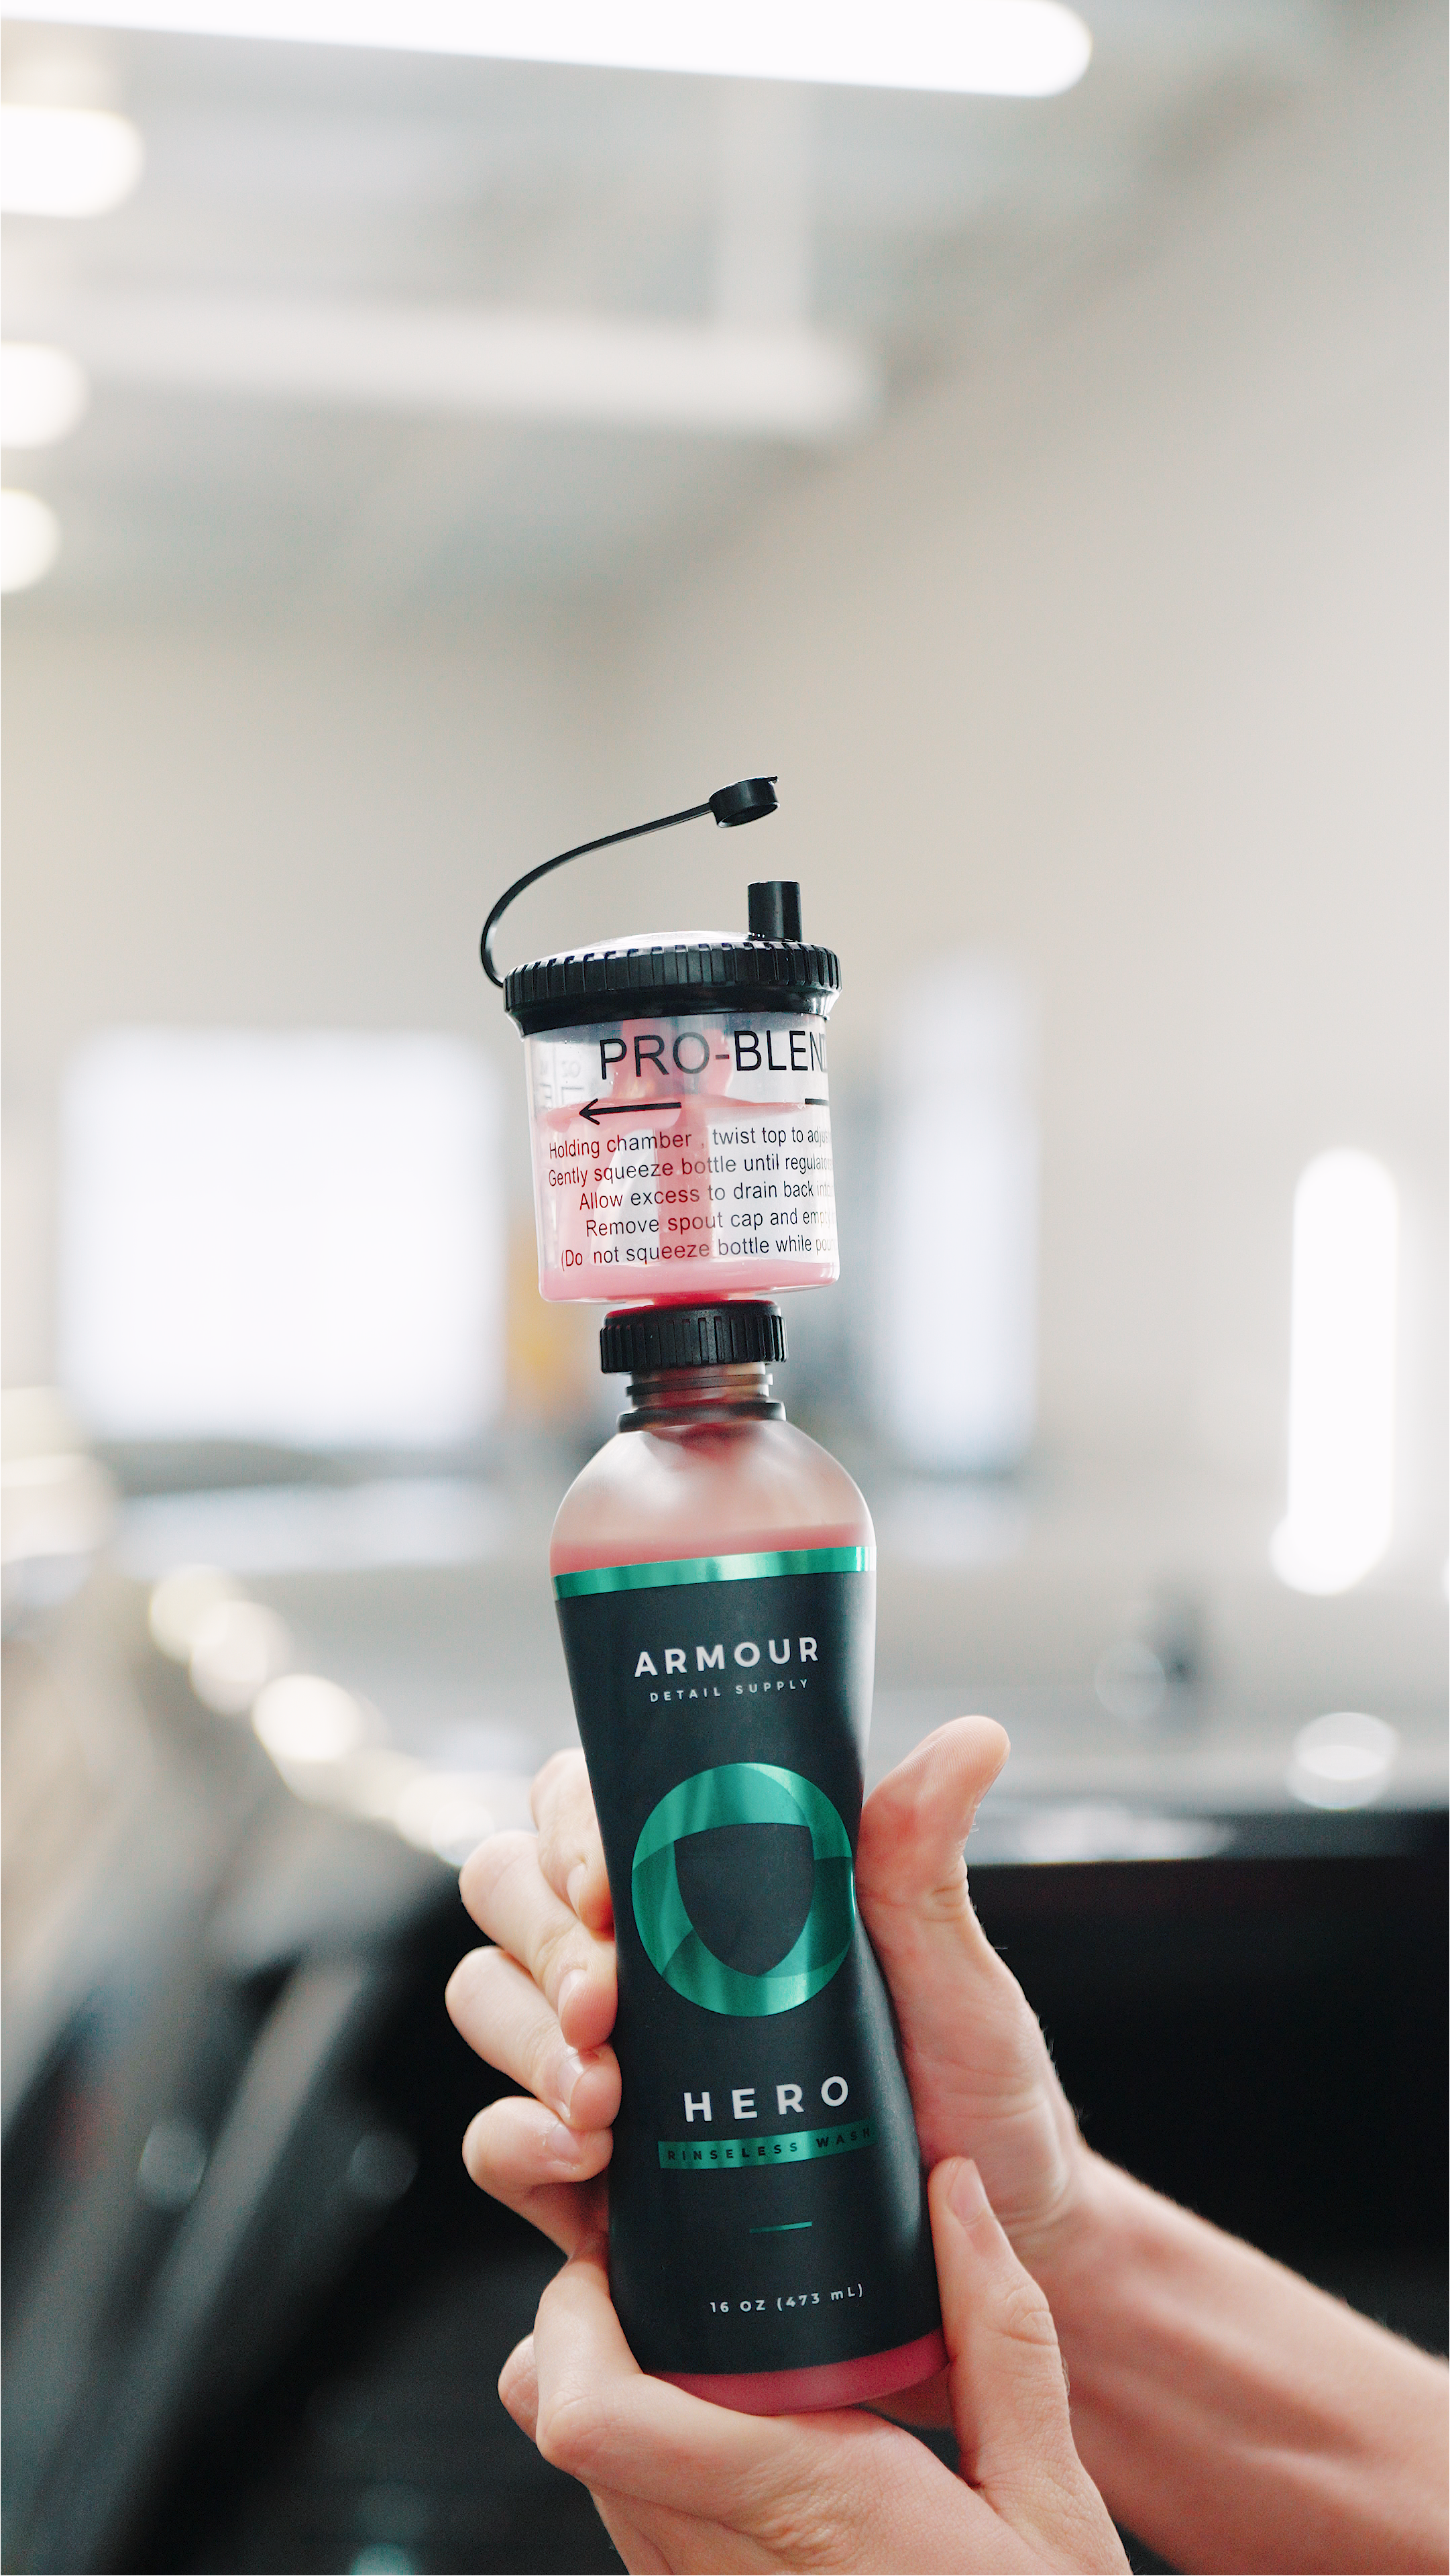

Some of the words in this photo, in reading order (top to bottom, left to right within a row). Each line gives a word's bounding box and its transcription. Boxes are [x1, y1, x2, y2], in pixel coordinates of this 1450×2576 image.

[549, 1139, 600, 1159] Holding
[712, 1127, 757, 1145] twist
[762, 1127, 786, 1147] top
[791, 1126, 803, 1143] to
[549, 1167, 588, 1187] Gently
[594, 1163, 673, 1184] squeeze
[682, 1155, 736, 1175] bottle
[744, 1153, 779, 1171] until
[579, 1191, 623, 1210] Allow
[630, 1188, 700, 1205] excess
[708, 1184, 726, 1201] to
[733, 1181, 777, 1199] drain
[783, 1181, 814, 1197] back
[586, 1218, 659, 1237] Remove
[667, 1212, 723, 1235] spout
[730, 1213, 763, 1230] cap
[770, 1208, 797, 1225] and
[803, 1210, 830, 1228] empty
[561, 1249, 583, 1272] (Do
[594, 1246, 619, 1263] not
[626, 1243, 710, 1265] squeeze
[718, 1237, 769, 1256] bottle
[775, 1234, 812, 1252] while
[634, 1636, 819, 1678] ARMOUR
[649, 1686, 721, 1703] DETAIL
[735, 1678, 807, 1695] SUPPLY
[683, 2076, 849, 2123] HERO
[667, 2142, 798, 2161] RINSELESS
[816, 2127, 870, 2148] WASH
[710, 2301, 730, 2313] 16
[739, 2299, 766, 2312] OZ
[776, 2292, 820, 2312] (473
[830, 2283, 863, 2301] mL)
